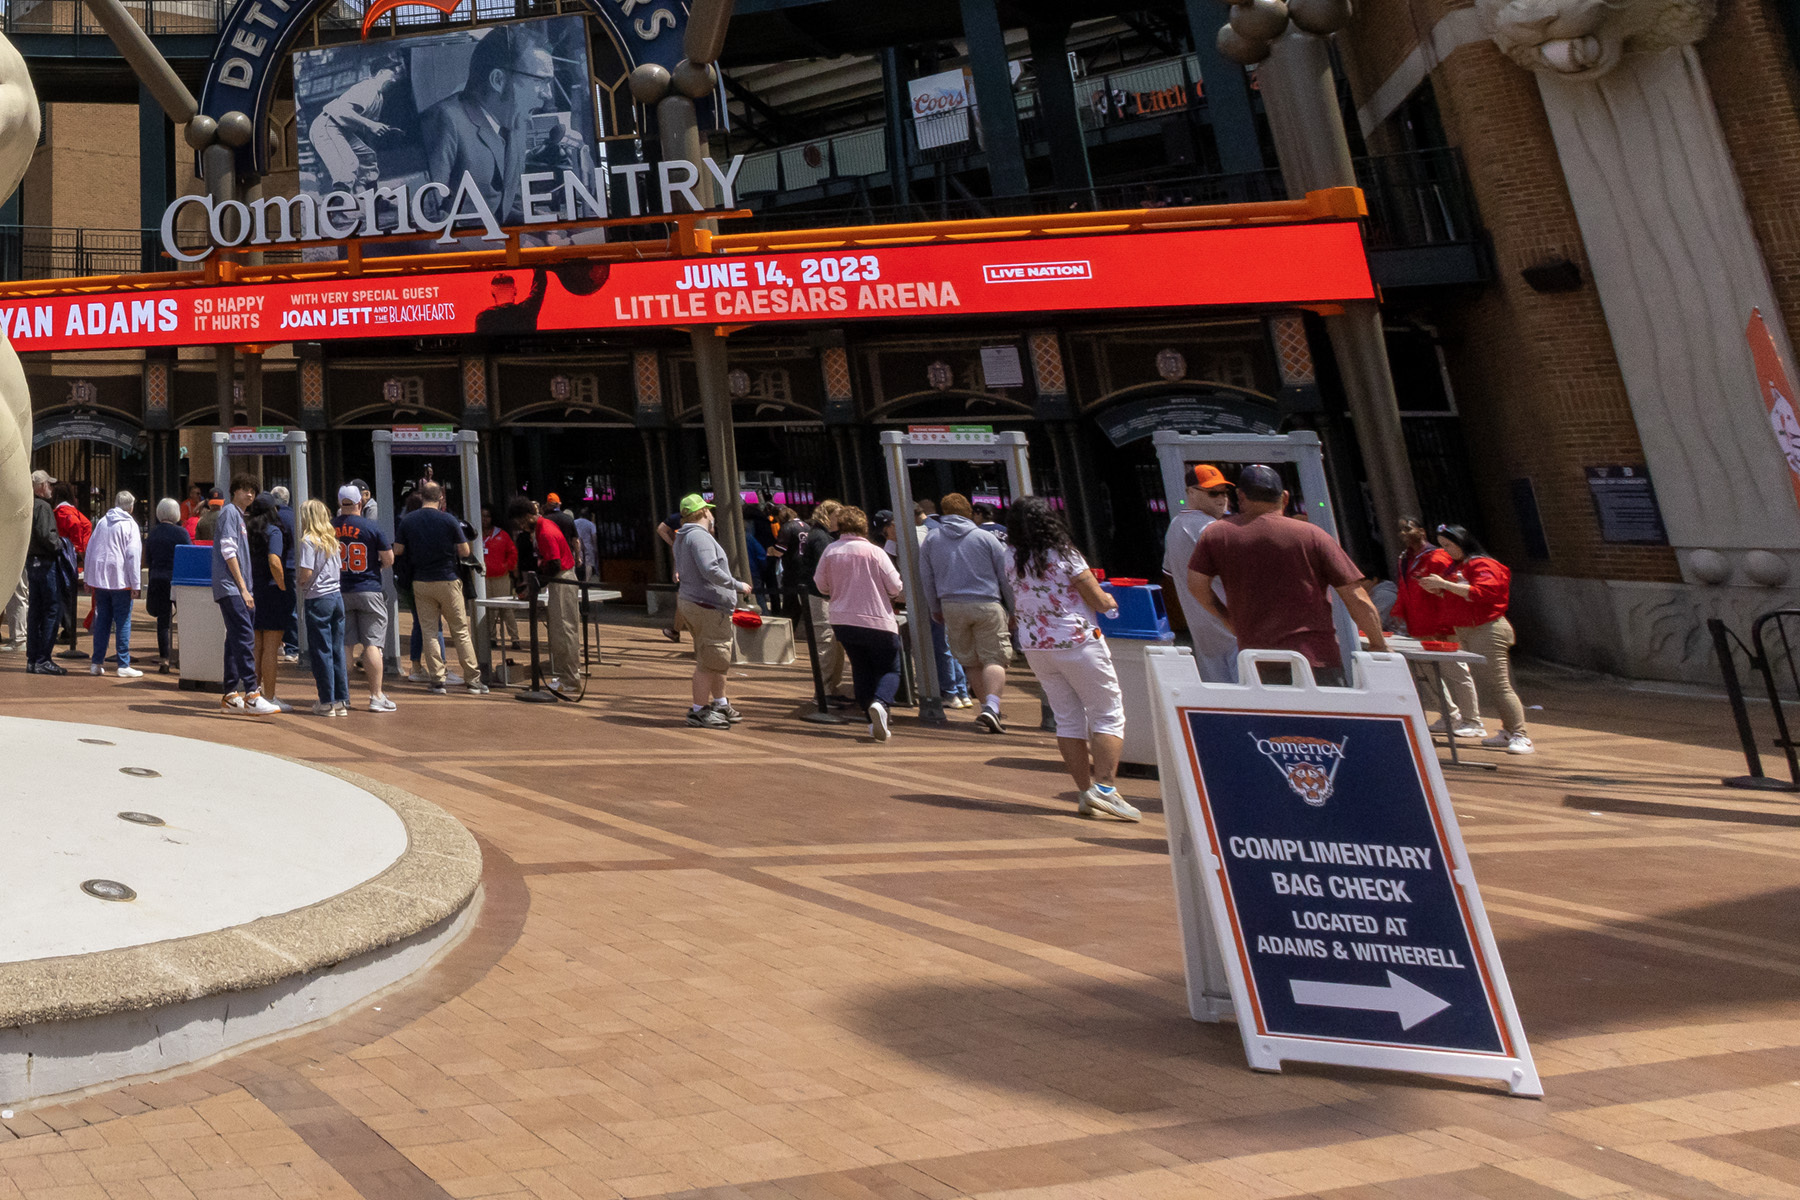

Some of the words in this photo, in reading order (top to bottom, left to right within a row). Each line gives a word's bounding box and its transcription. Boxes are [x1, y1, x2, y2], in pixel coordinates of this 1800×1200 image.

[913, 90, 965, 114] Coors
[520, 154, 744, 224] ENTRY
[675, 263, 748, 290] JUNE
[754, 261, 793, 288] 14,
[800, 255, 881, 284] 2023
[991, 267, 1024, 279] LIVE
[1028, 265, 1085, 277] NATION
[194, 298, 213, 314] SO
[217, 296, 265, 313] HAPPY
[290, 294, 318, 305] WITH
[321, 291, 349, 304] VERY
[352, 289, 399, 302] SPECIAL
[402, 286, 439, 300] GUEST
[615, 292, 706, 320] LITTLE
[714, 286, 847, 315] CAESARS
[857, 281, 961, 310] ARENA
[65, 298, 178, 337] ADAMS
[194, 315, 206, 331] IT
[212, 313, 260, 330] HURTS
[280, 309, 326, 329] JOAN
[330, 307, 373, 327] JETT
[389, 303, 456, 323] BLACKHEARTS
[1283, 753, 1323, 762] PARK
[1229, 836, 1431, 870] COMPLIMENTARY
[1272, 872, 1322, 897] BAG
[1328, 876, 1412, 903] CHECK
[1292, 910, 1379, 935] LOCATED
[1385, 918, 1407, 936] AT
[1257, 935, 1328, 960] ADAMS
[1332, 941, 1350, 960] &
[1351, 943, 1465, 969] WITHERELL
